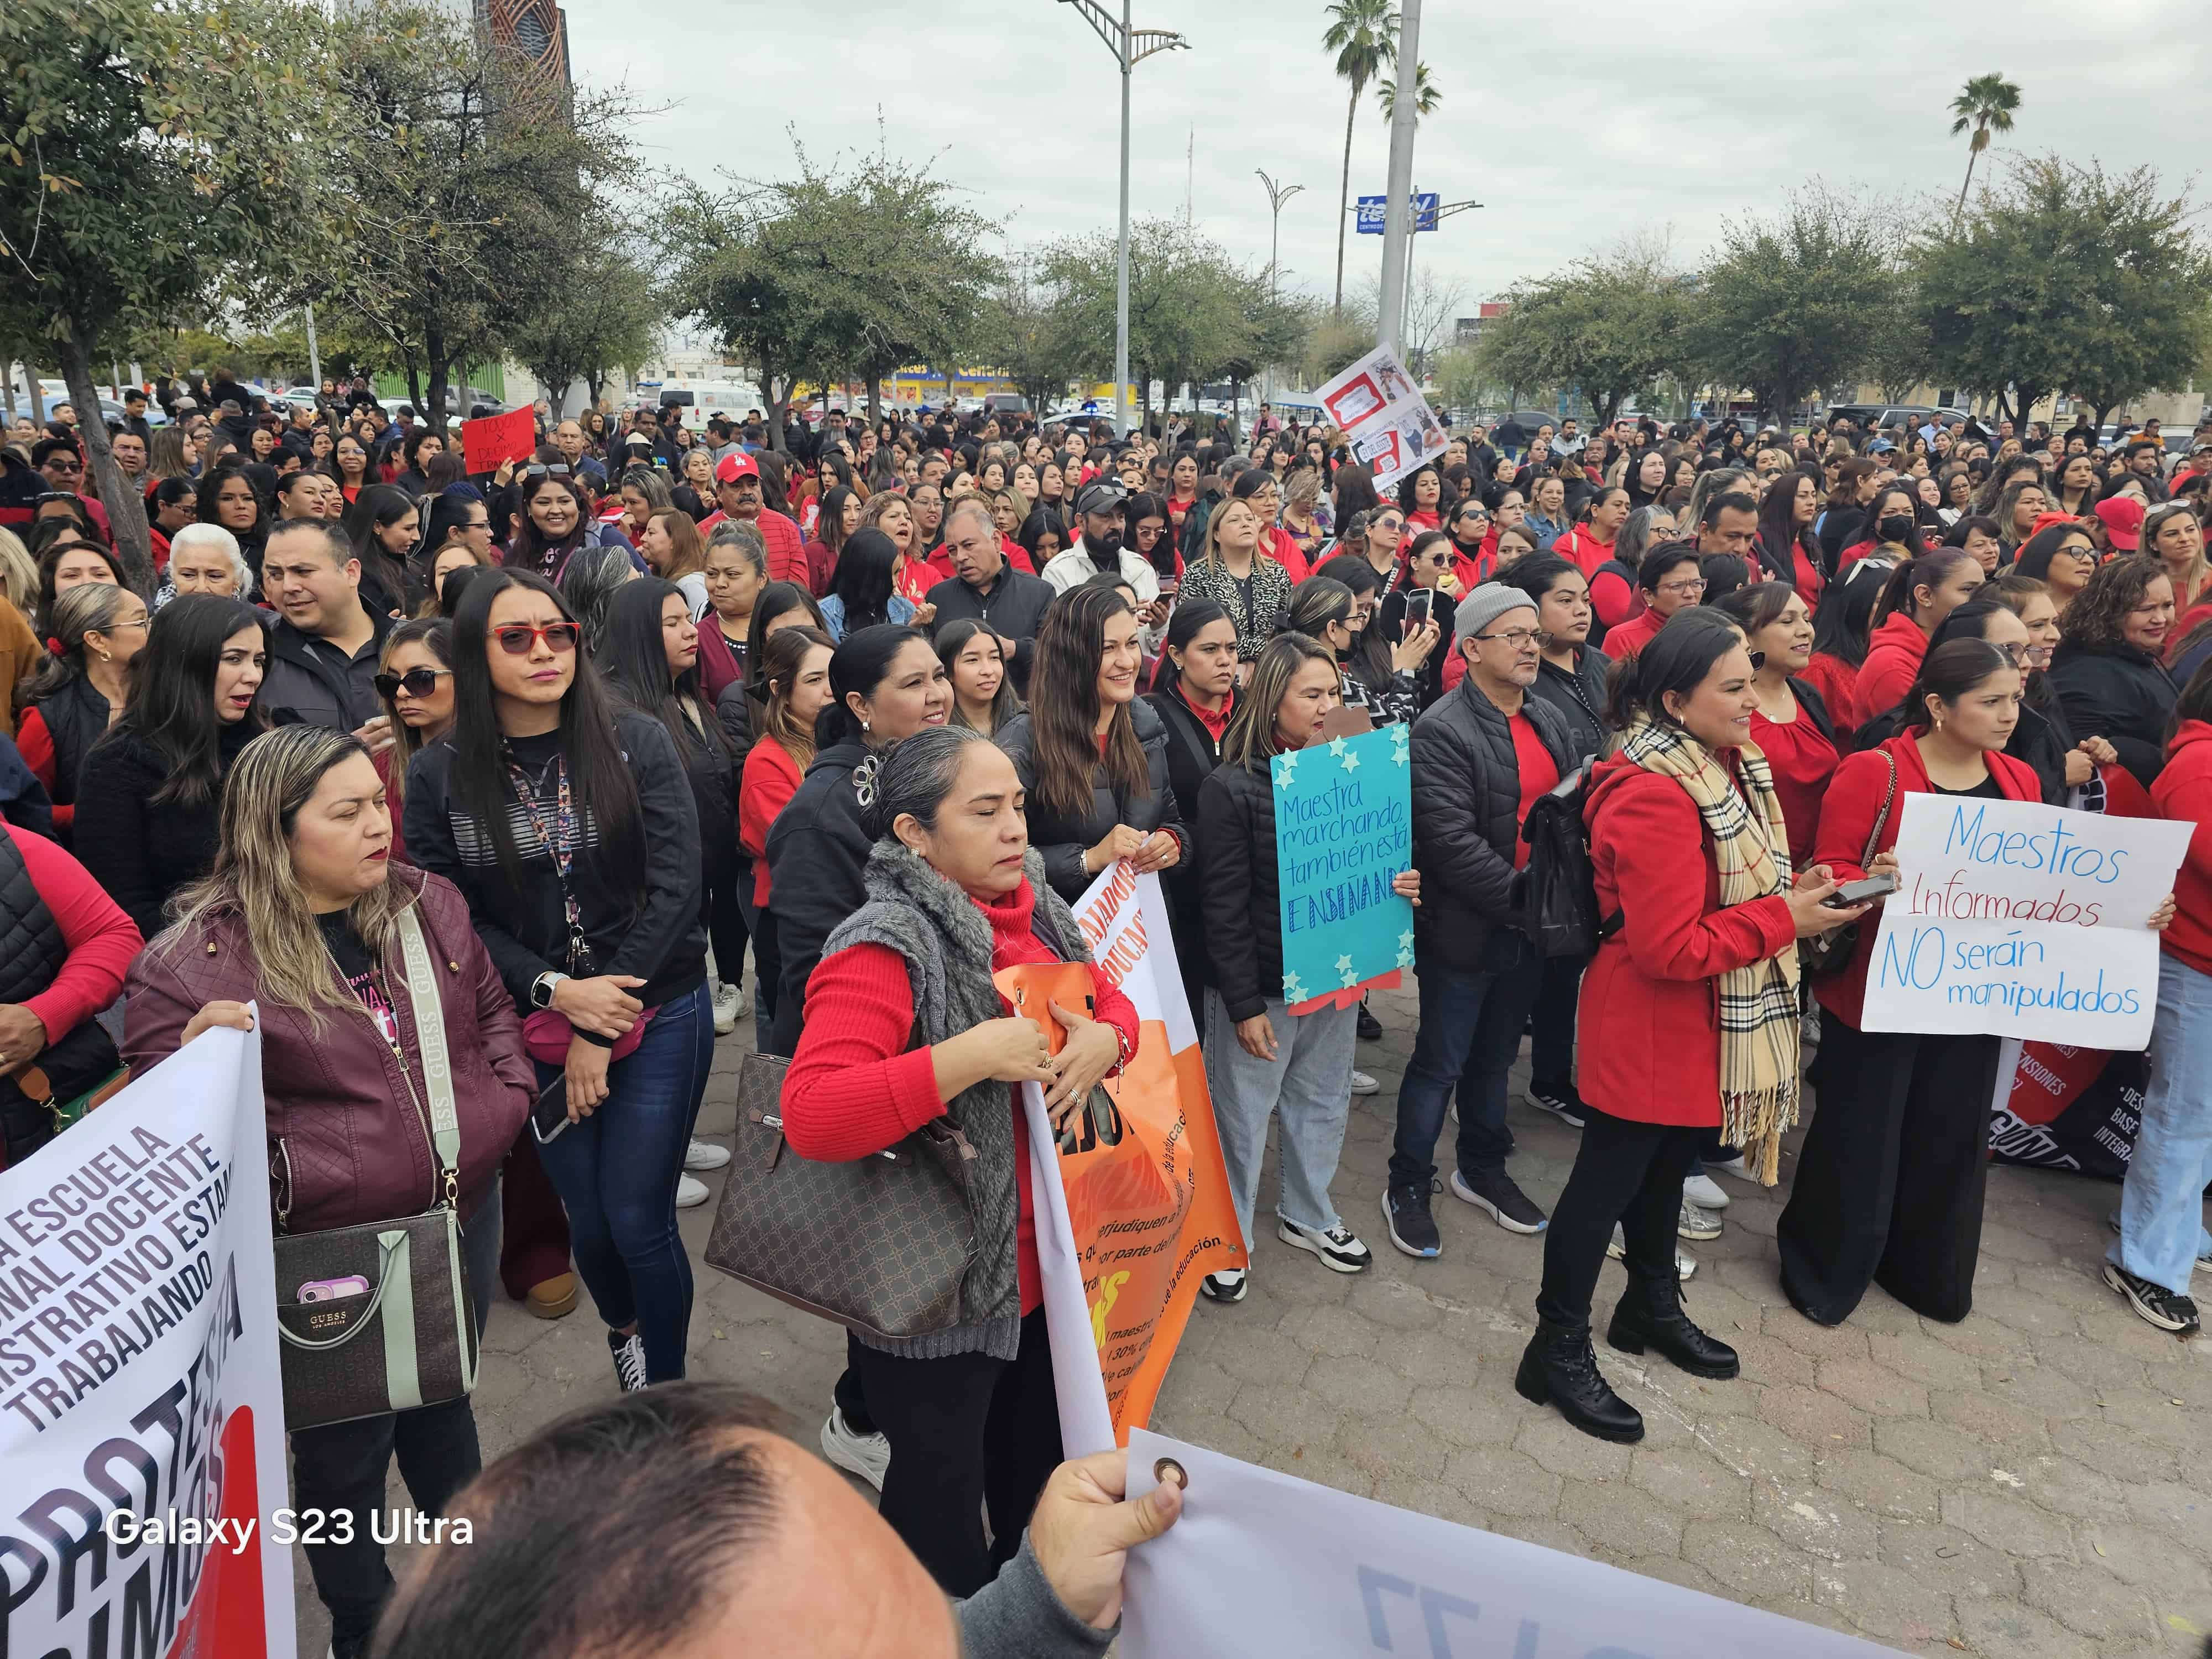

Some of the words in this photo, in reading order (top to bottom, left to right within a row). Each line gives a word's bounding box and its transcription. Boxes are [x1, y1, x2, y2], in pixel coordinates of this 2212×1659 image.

[1283, 778, 1363, 826] Maestra
[1285, 839, 1374, 887] también
[1376, 822, 1407, 858] está
[1945, 805, 2128, 884] Maestros
[1908, 869, 2102, 927] Informados
[406, 933, 431, 994] GUESS
[1881, 927, 1945, 990] NO
[1952, 930, 2044, 970] serán
[1948, 969, 2140, 1016] manipulados
[420, 1011, 444, 1078] GUESS
[2110, 1107, 2139, 1134] BASE
[2124, 1087, 2146, 1113] DES
[4, 1126, 171, 1248] ESCUELA
[0, 1255, 76, 1322] NAL
[57, 1133, 220, 1266] DOCENTE
[1112, 1244, 1151, 1263] parte
[1168, 1277, 1177, 1291] la
[1176, 1237, 1221, 1280] educación
[2, 1250, 213, 1433] TRABAJANDO
[310, 1311, 346, 1324] GUESS
